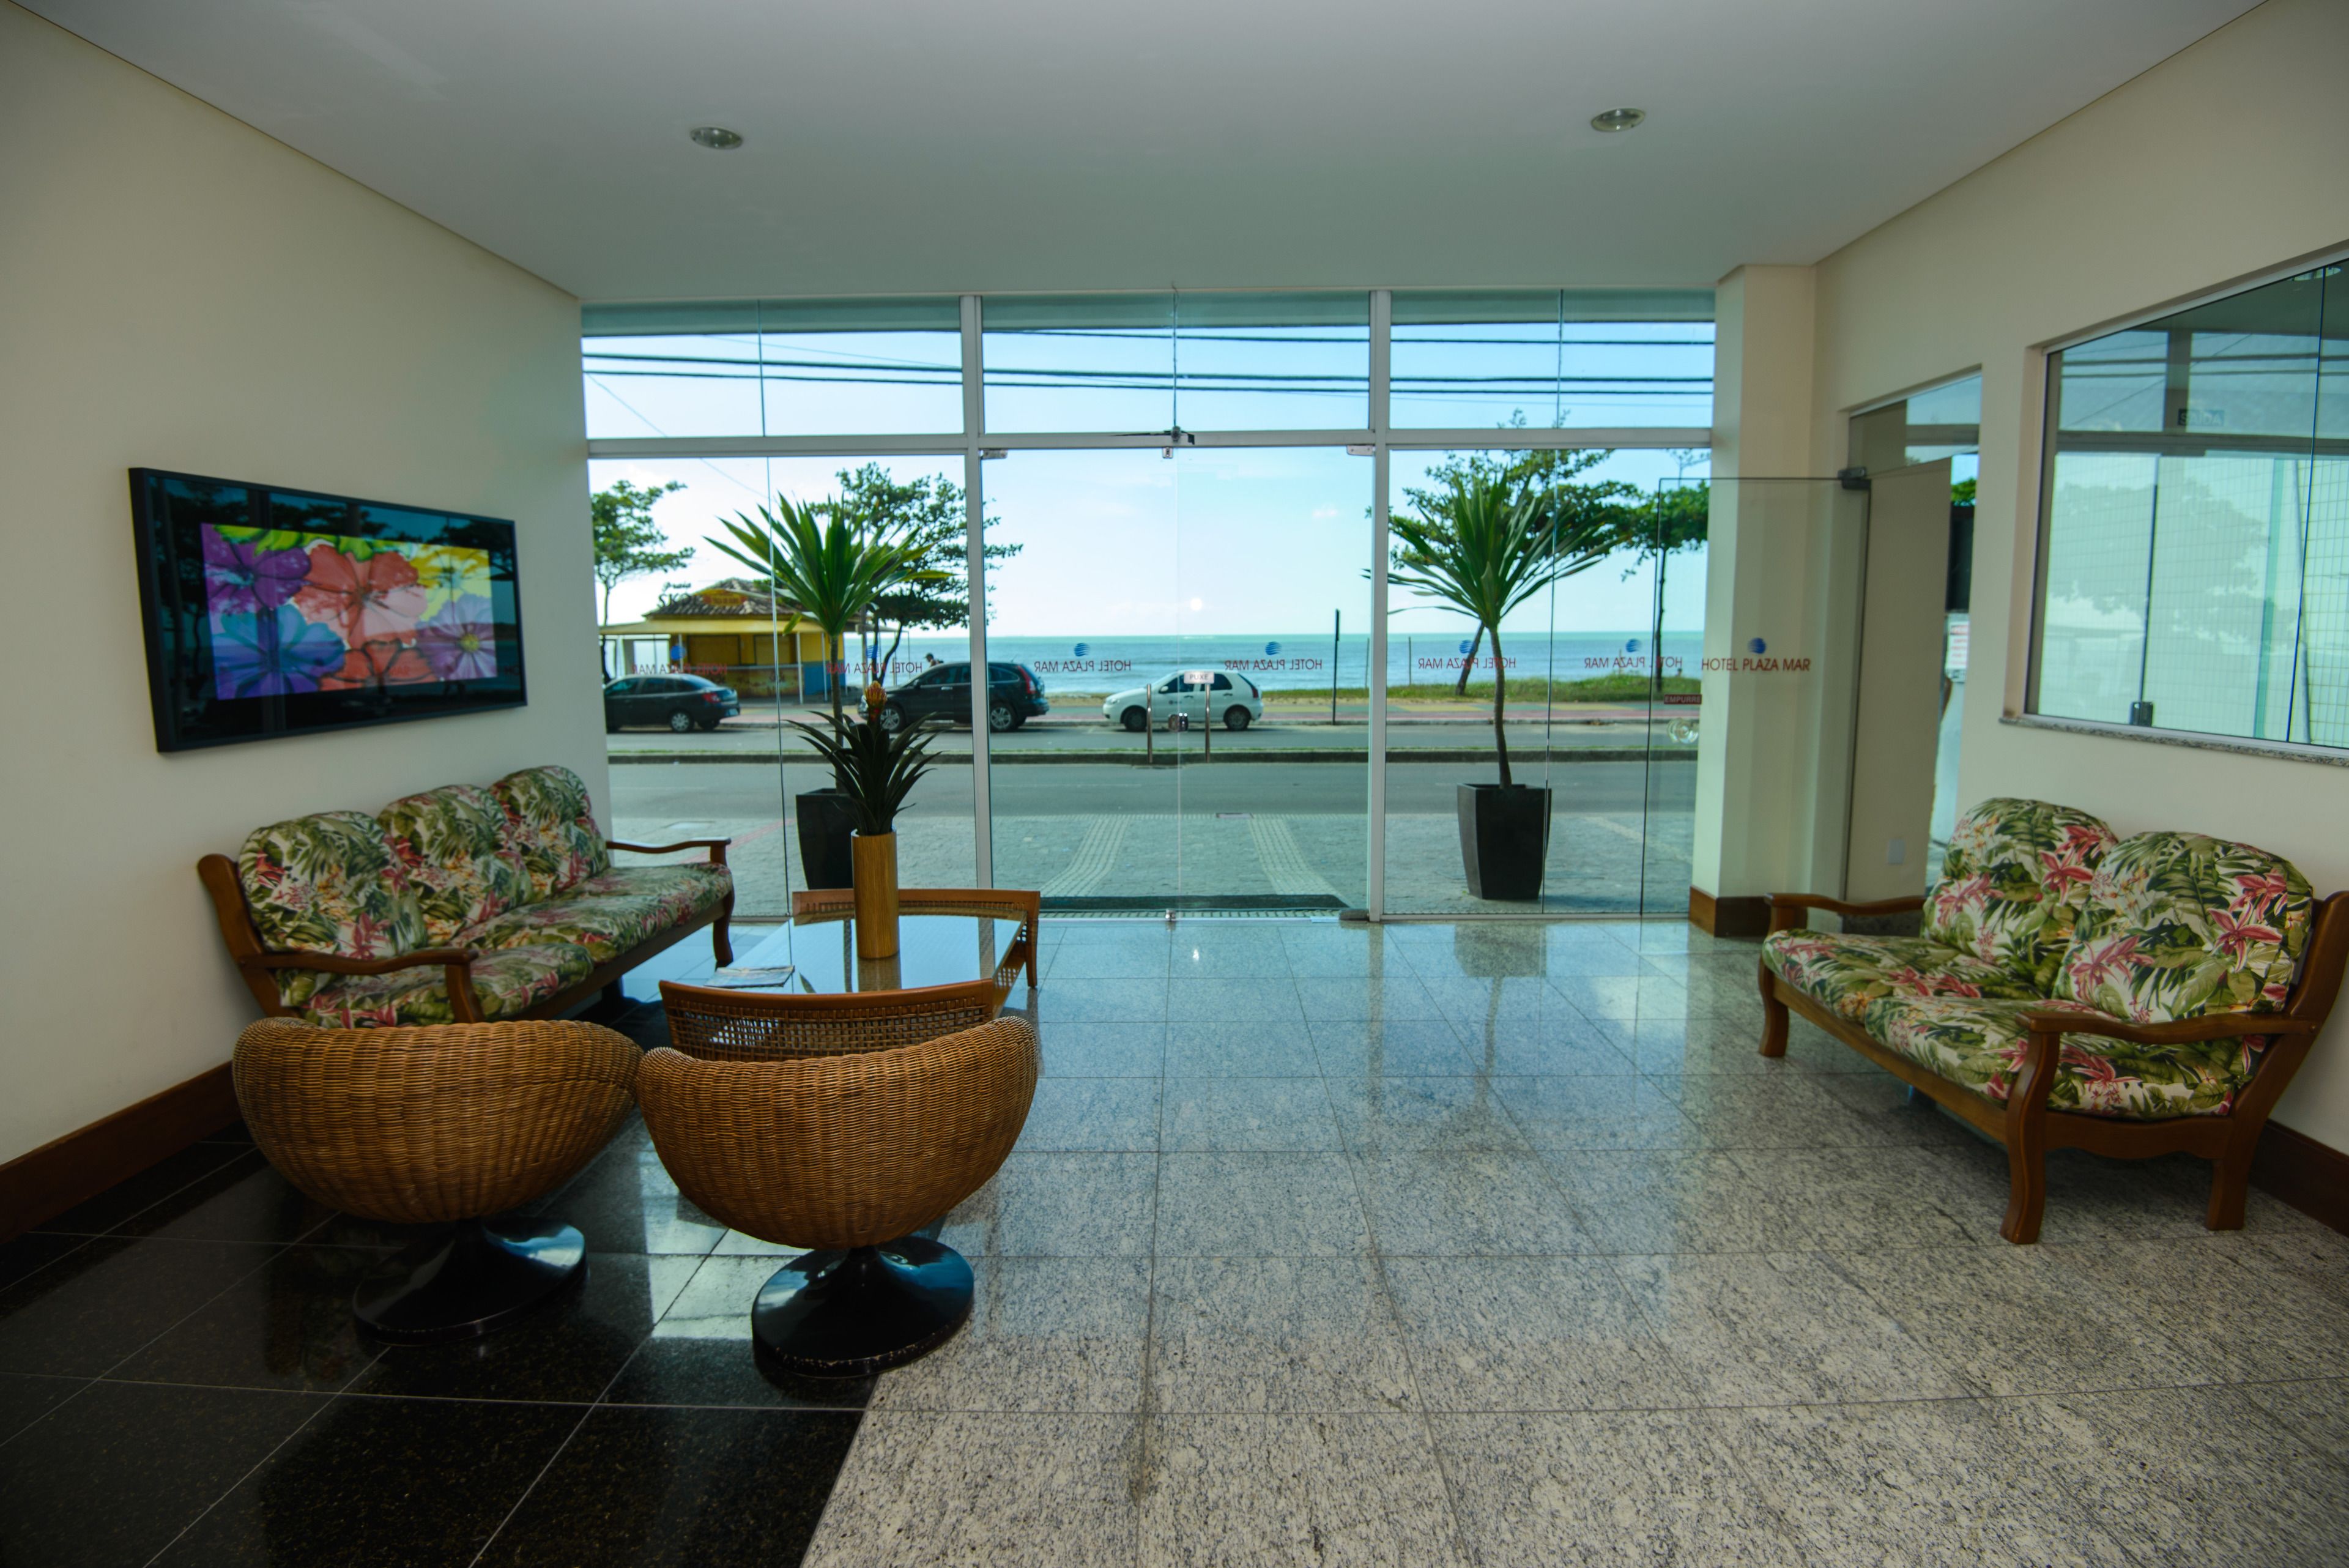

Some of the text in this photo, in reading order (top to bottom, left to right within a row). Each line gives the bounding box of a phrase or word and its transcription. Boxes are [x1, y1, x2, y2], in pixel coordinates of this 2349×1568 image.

[1701, 658, 1811, 671] HOTEL PLAZA MAR
